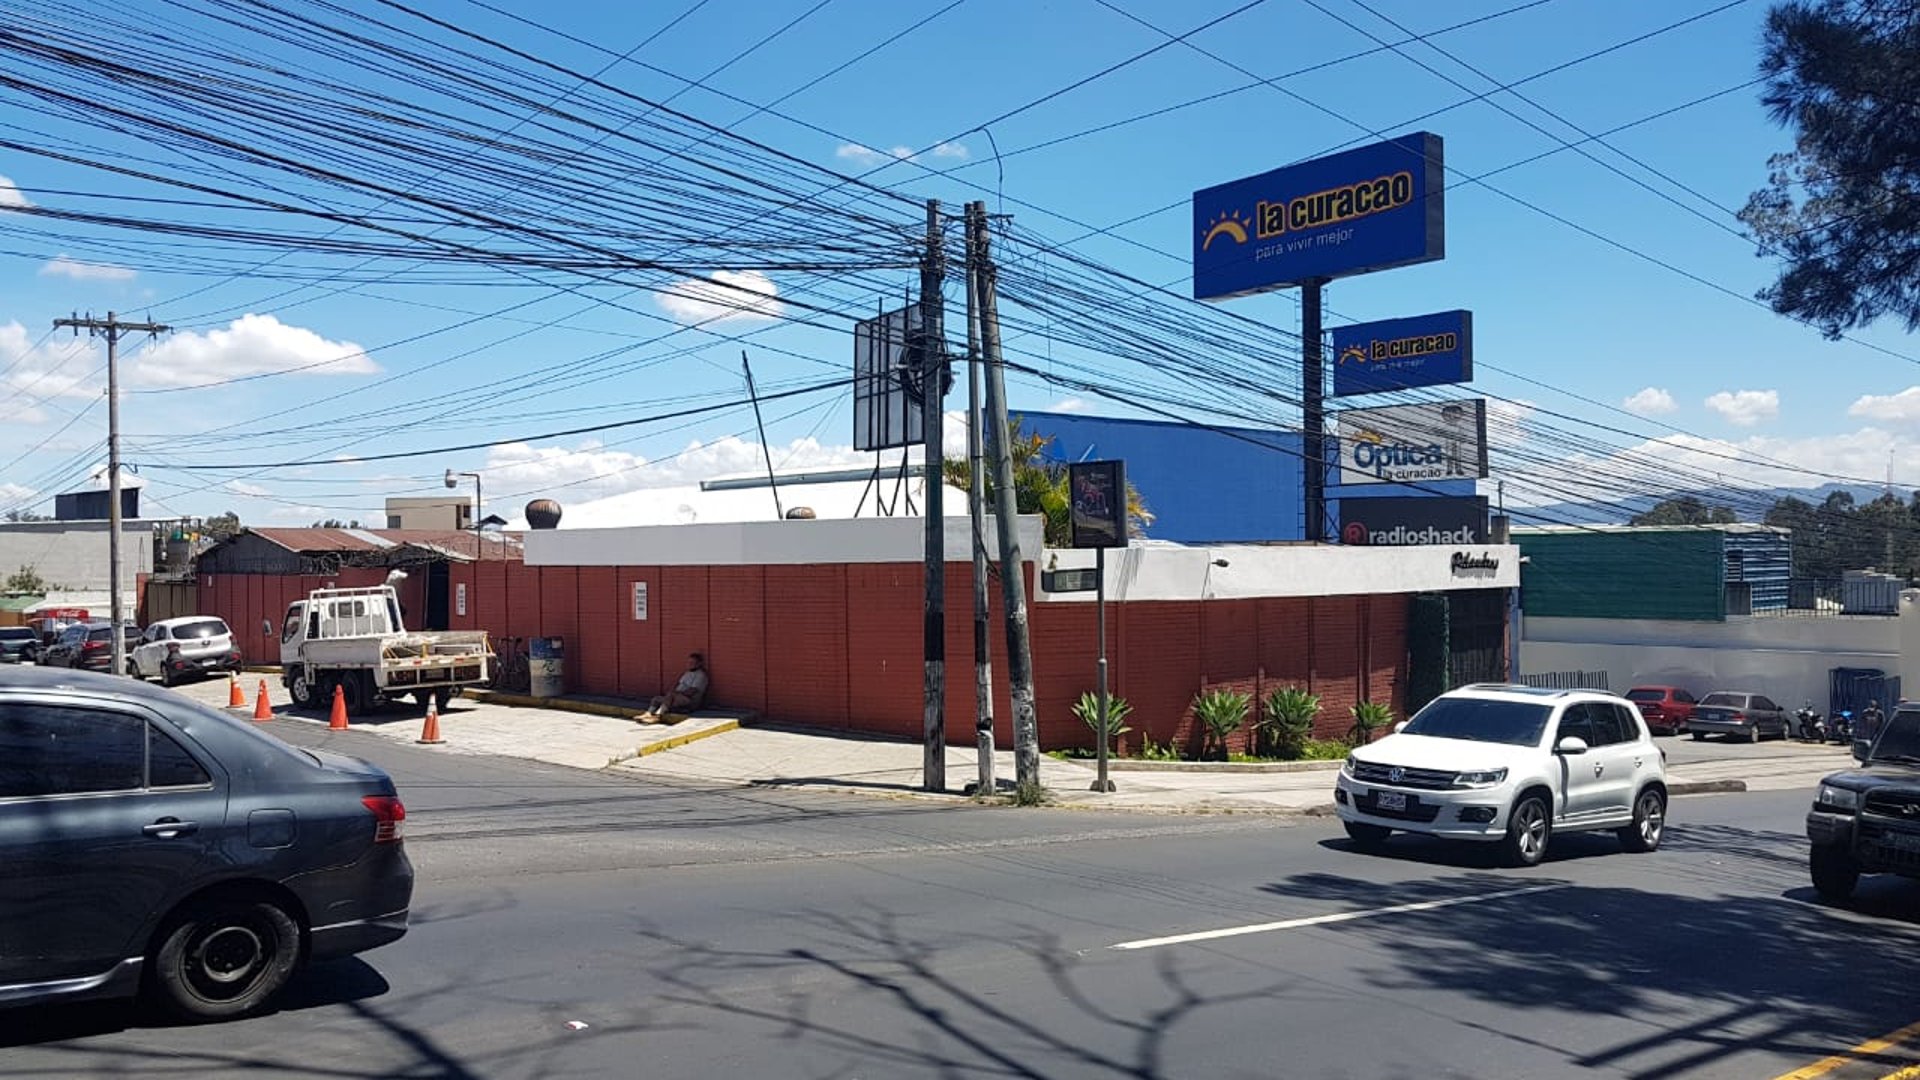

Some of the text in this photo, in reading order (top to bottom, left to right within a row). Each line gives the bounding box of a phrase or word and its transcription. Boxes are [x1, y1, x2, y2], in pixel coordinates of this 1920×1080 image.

[1258, 173, 1411, 236] la curacao
[1255, 228, 1354, 262] para vivir mejor
[1371, 333, 1456, 359] la curacao
[1395, 468, 1441, 479] curacao
[1368, 525, 1476, 544] radioshack
